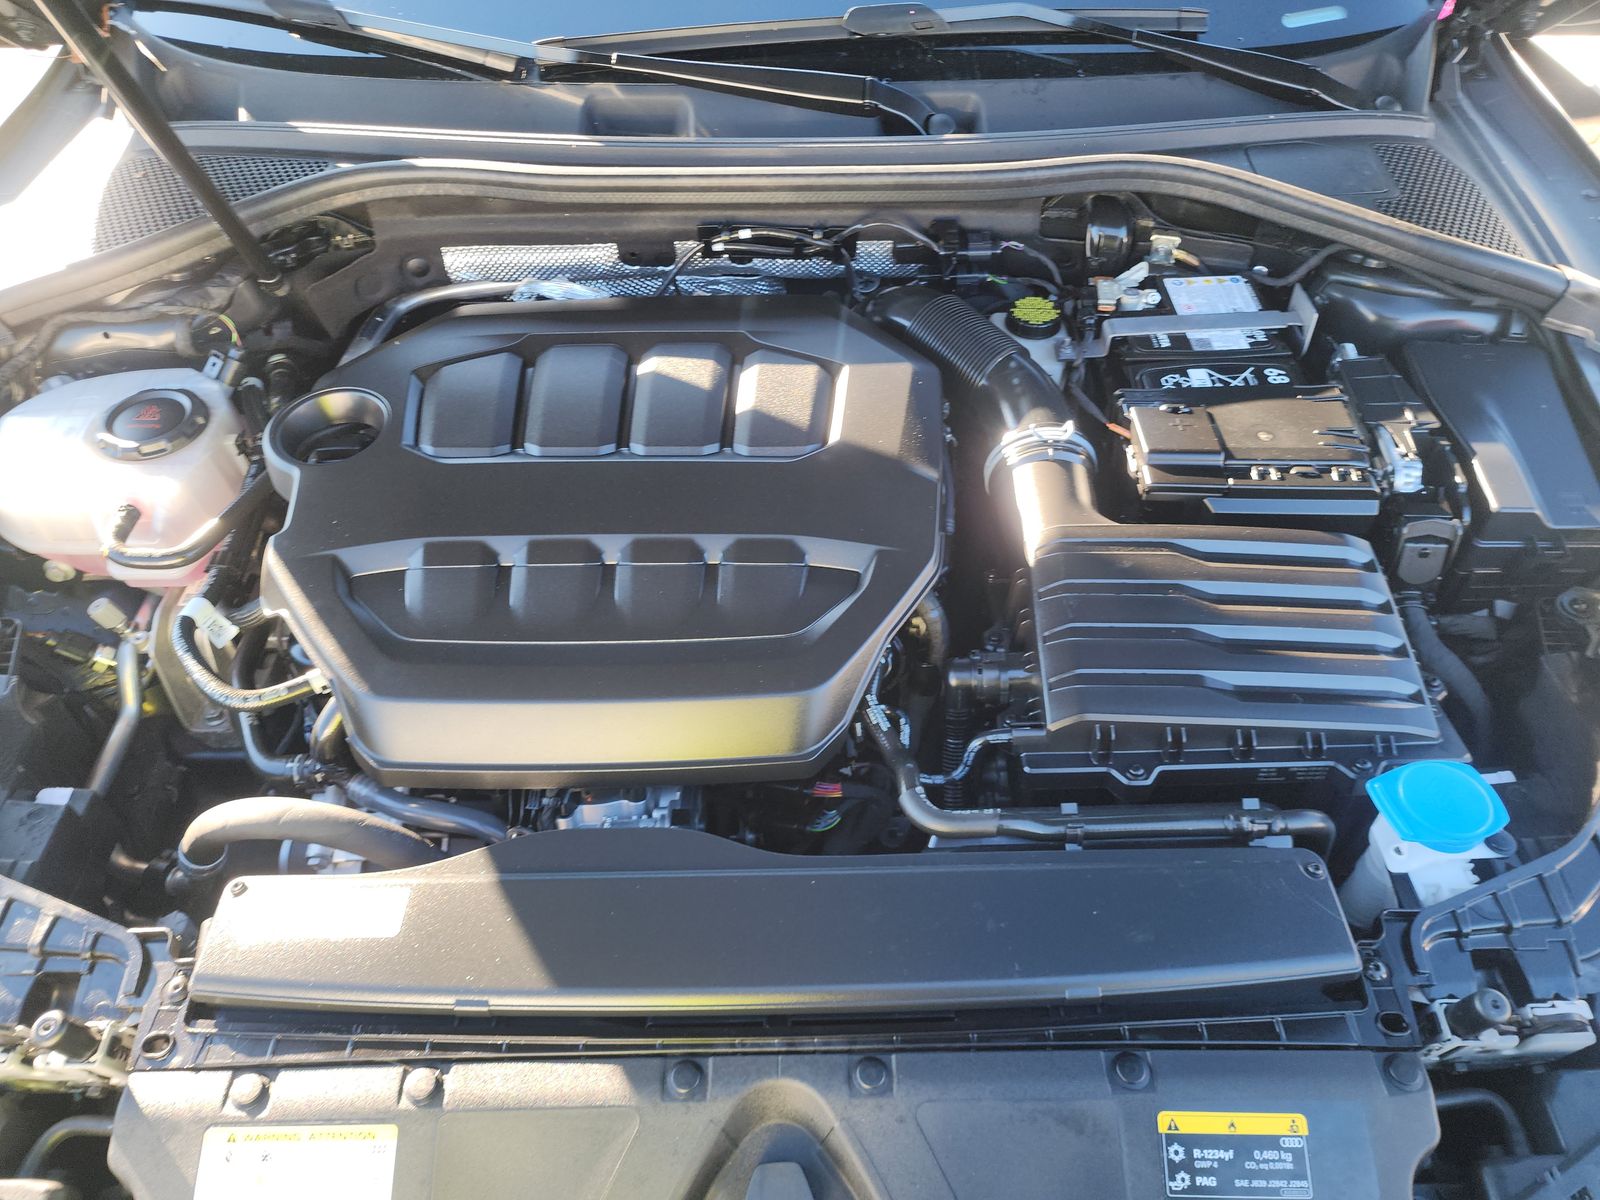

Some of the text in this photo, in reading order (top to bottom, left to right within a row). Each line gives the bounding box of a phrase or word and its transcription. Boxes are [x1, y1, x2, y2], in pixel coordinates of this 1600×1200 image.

[1193, 1149, 1234, 1161] R-1234yf
[1280, 1151, 1293, 1162] kg
[1194, 1161, 1213, 1169] GWP
[1195, 1177, 1218, 1187] PAG
[1234, 1179, 1250, 1188] SAE
